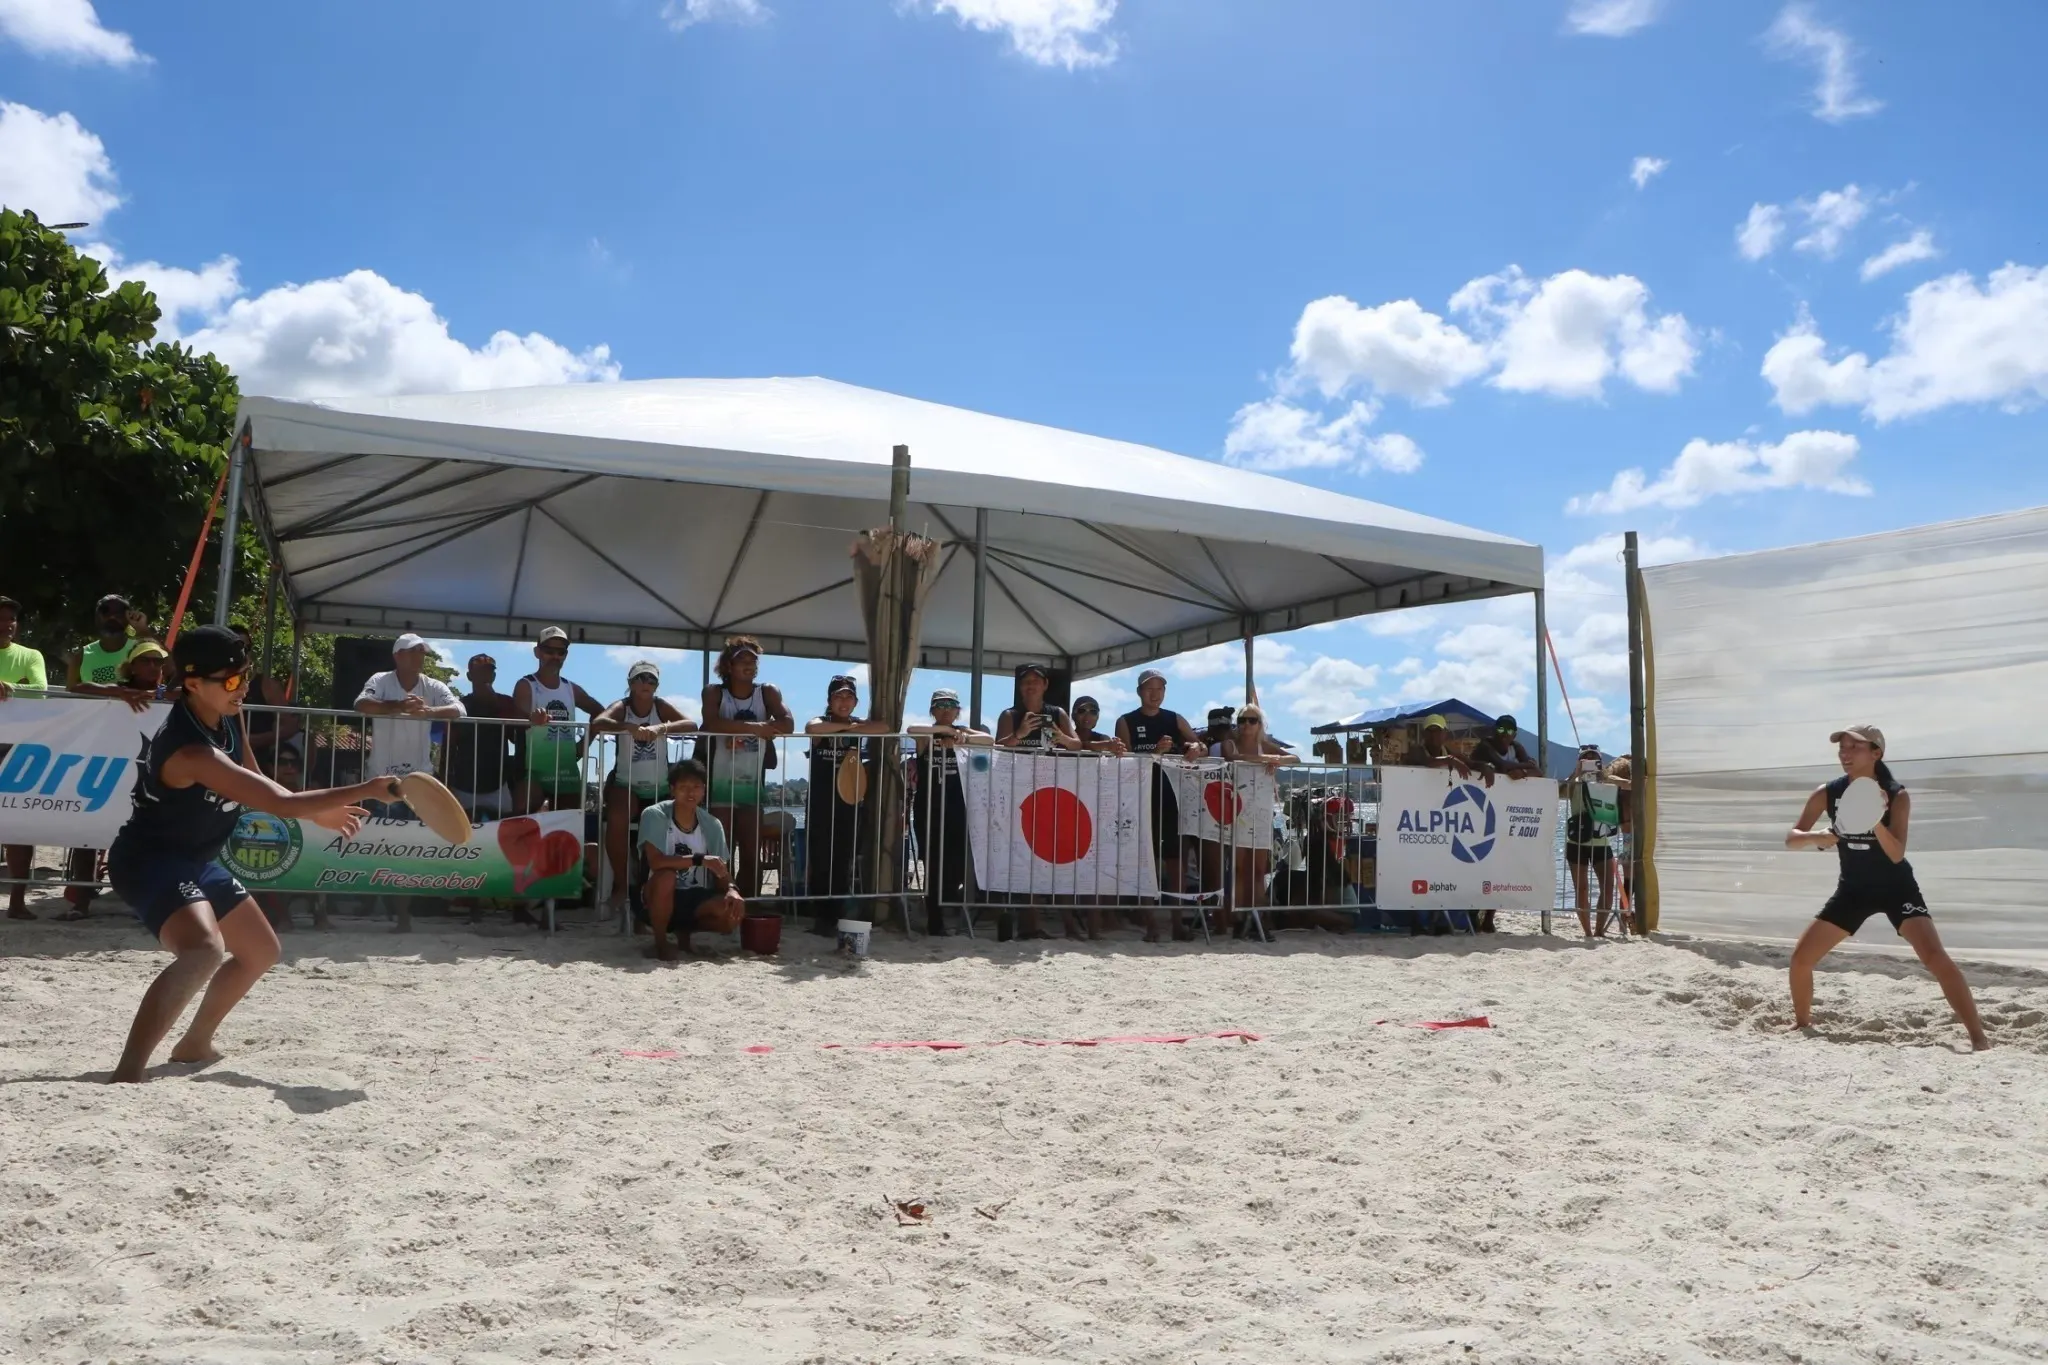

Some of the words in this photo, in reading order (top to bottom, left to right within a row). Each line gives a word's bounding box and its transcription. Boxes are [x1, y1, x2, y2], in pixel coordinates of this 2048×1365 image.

[22, 797, 82, 813] SPORTS
[1505, 805, 1534, 815] FRESCOBOL
[1536, 807, 1544, 815] DE
[1396, 809, 1475, 834] ALPHA
[1509, 815, 1541, 824] COMPETIÇÃO
[1509, 823, 1516, 837] É
[1517, 826, 1540, 838] AQUI
[1399, 833, 1450, 845] FRESCOBOL
[323, 836, 483, 860] Apaixonados
[316, 867, 366, 888] por
[369, 867, 488, 890] Frescobol
[1429, 883, 1457, 892] alphatv
